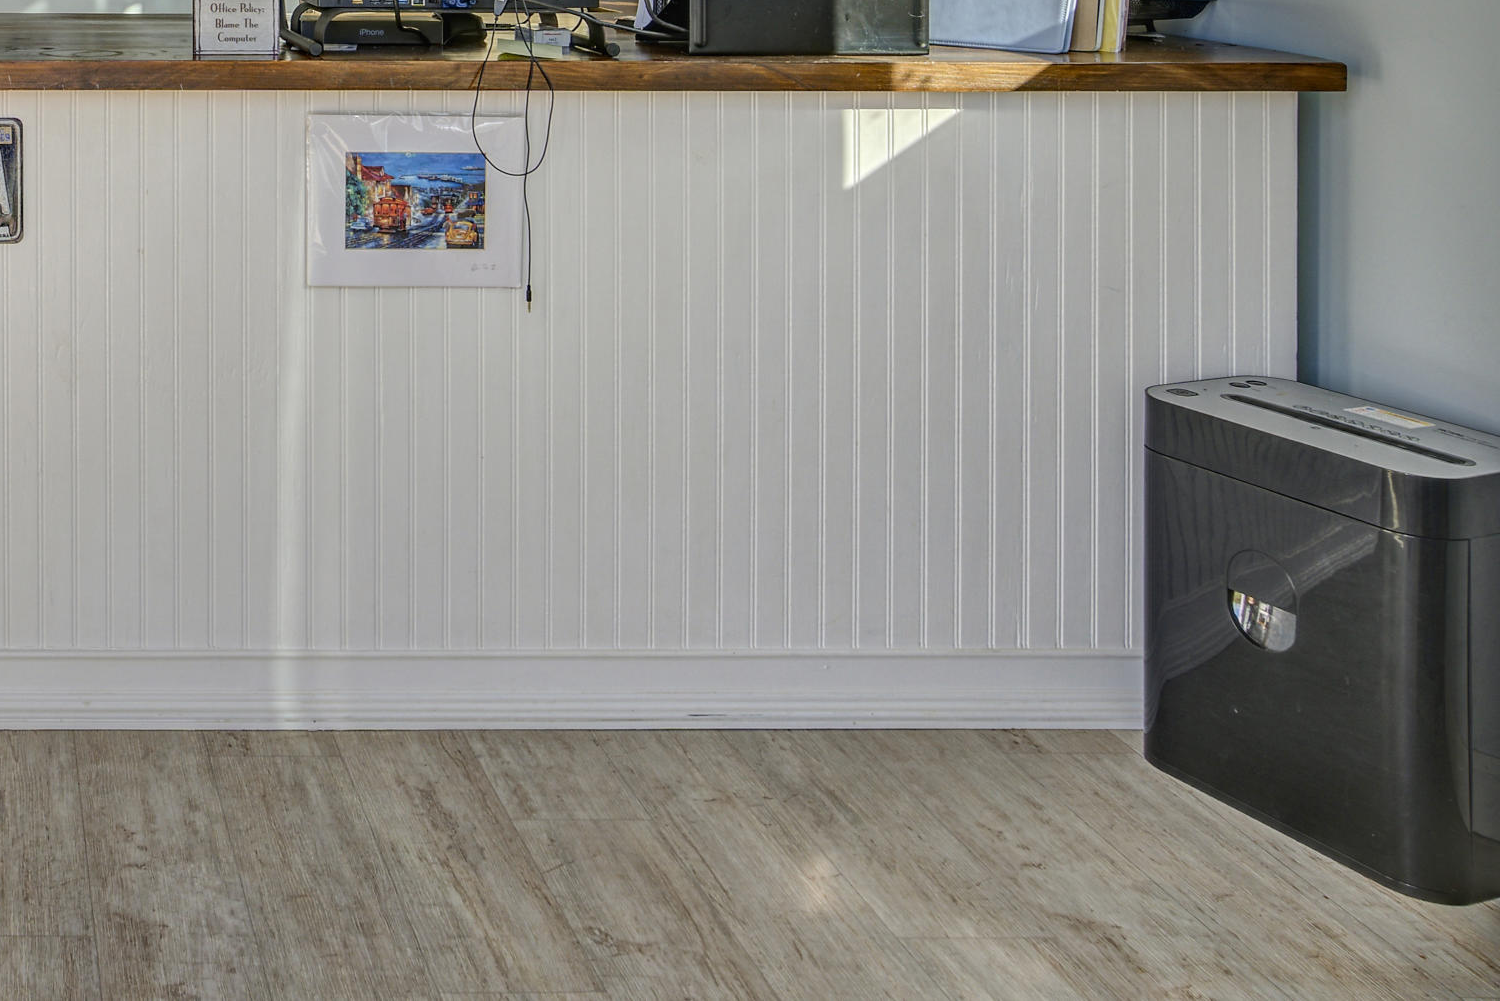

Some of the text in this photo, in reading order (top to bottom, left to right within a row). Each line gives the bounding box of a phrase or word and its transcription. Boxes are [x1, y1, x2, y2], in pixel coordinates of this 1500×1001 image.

[209, 2, 265, 15] Office Policy:
[215, 18, 259, 29] Blame The
[217, 31, 257, 44] Computer
[359, 28, 385, 37] iPhone
